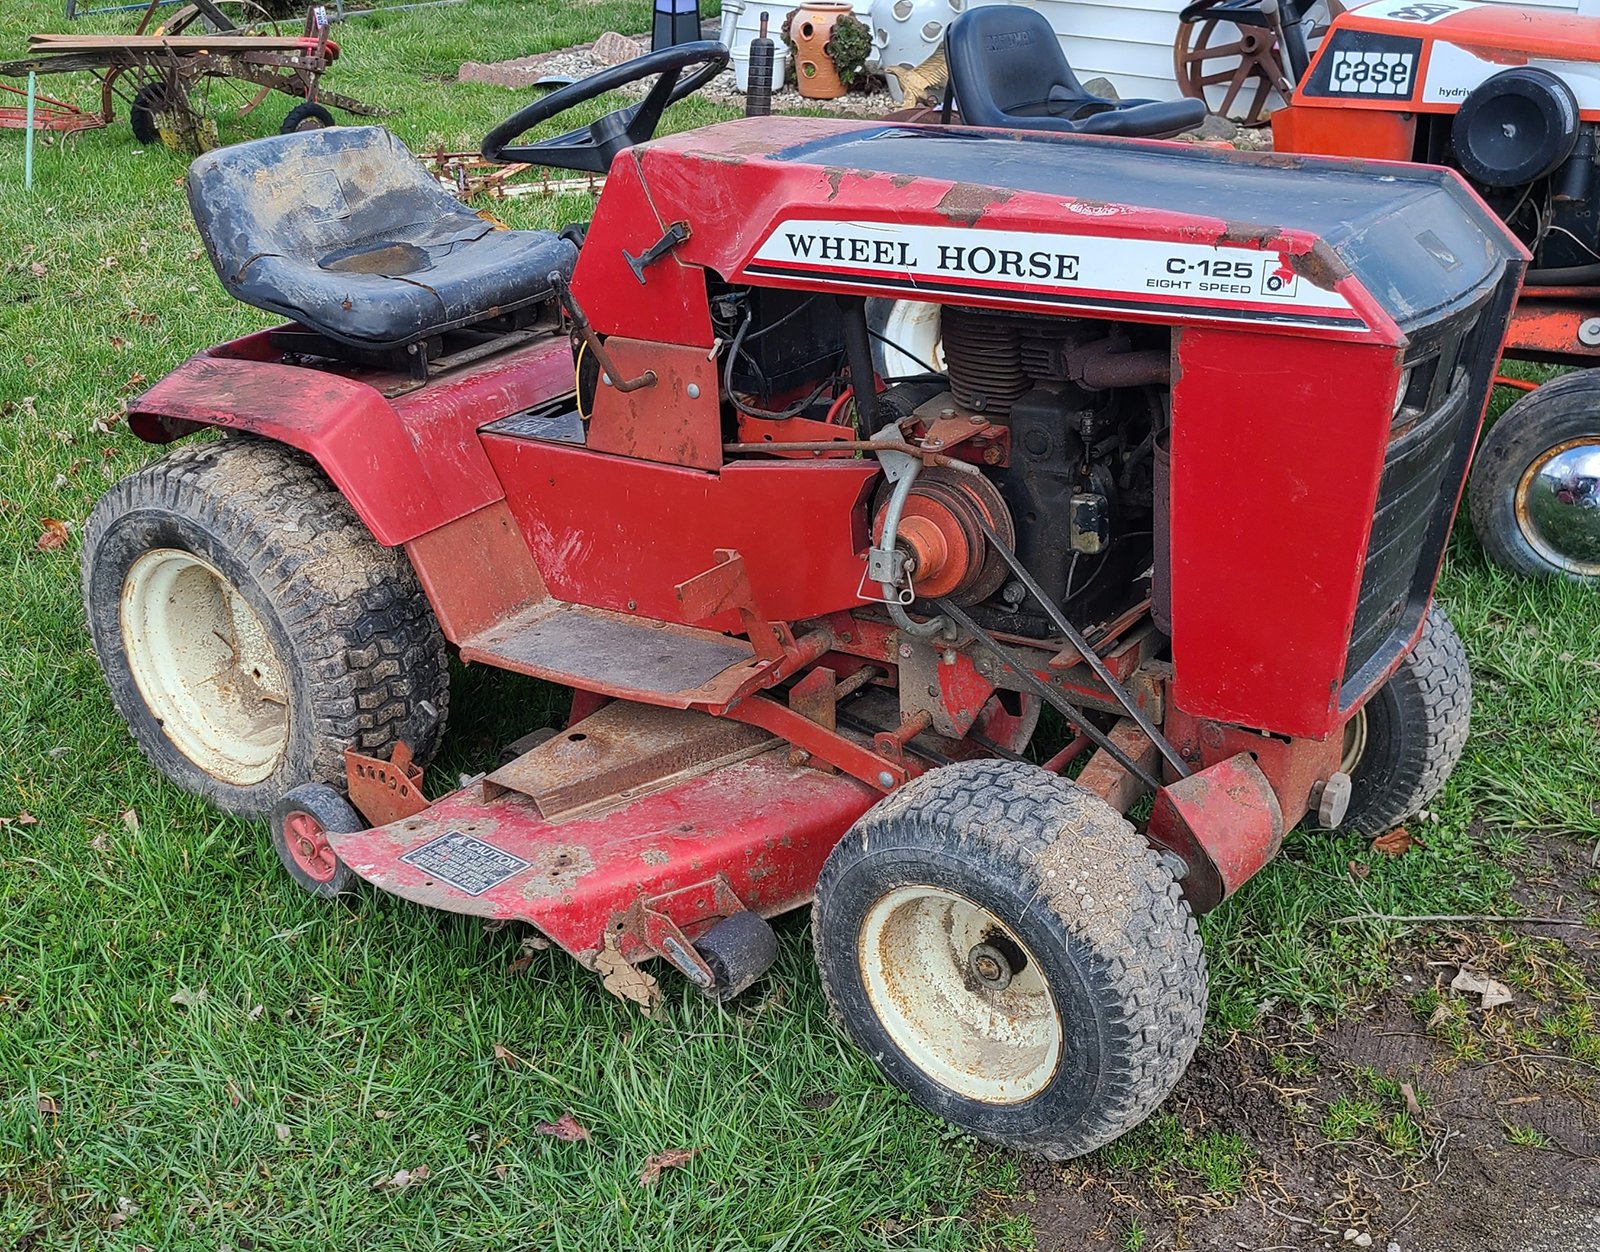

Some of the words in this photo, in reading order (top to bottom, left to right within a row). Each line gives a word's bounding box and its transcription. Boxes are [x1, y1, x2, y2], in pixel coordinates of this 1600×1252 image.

[785, 233, 917, 267] WHEEL
[937, 245, 1080, 281] HORSE
[1166, 257, 1253, 279] C-125
[1146, 278, 1192, 290] EIGHT
[1199, 282, 1252, 294] SPEED
[466, 842, 520, 869] CAUTION
